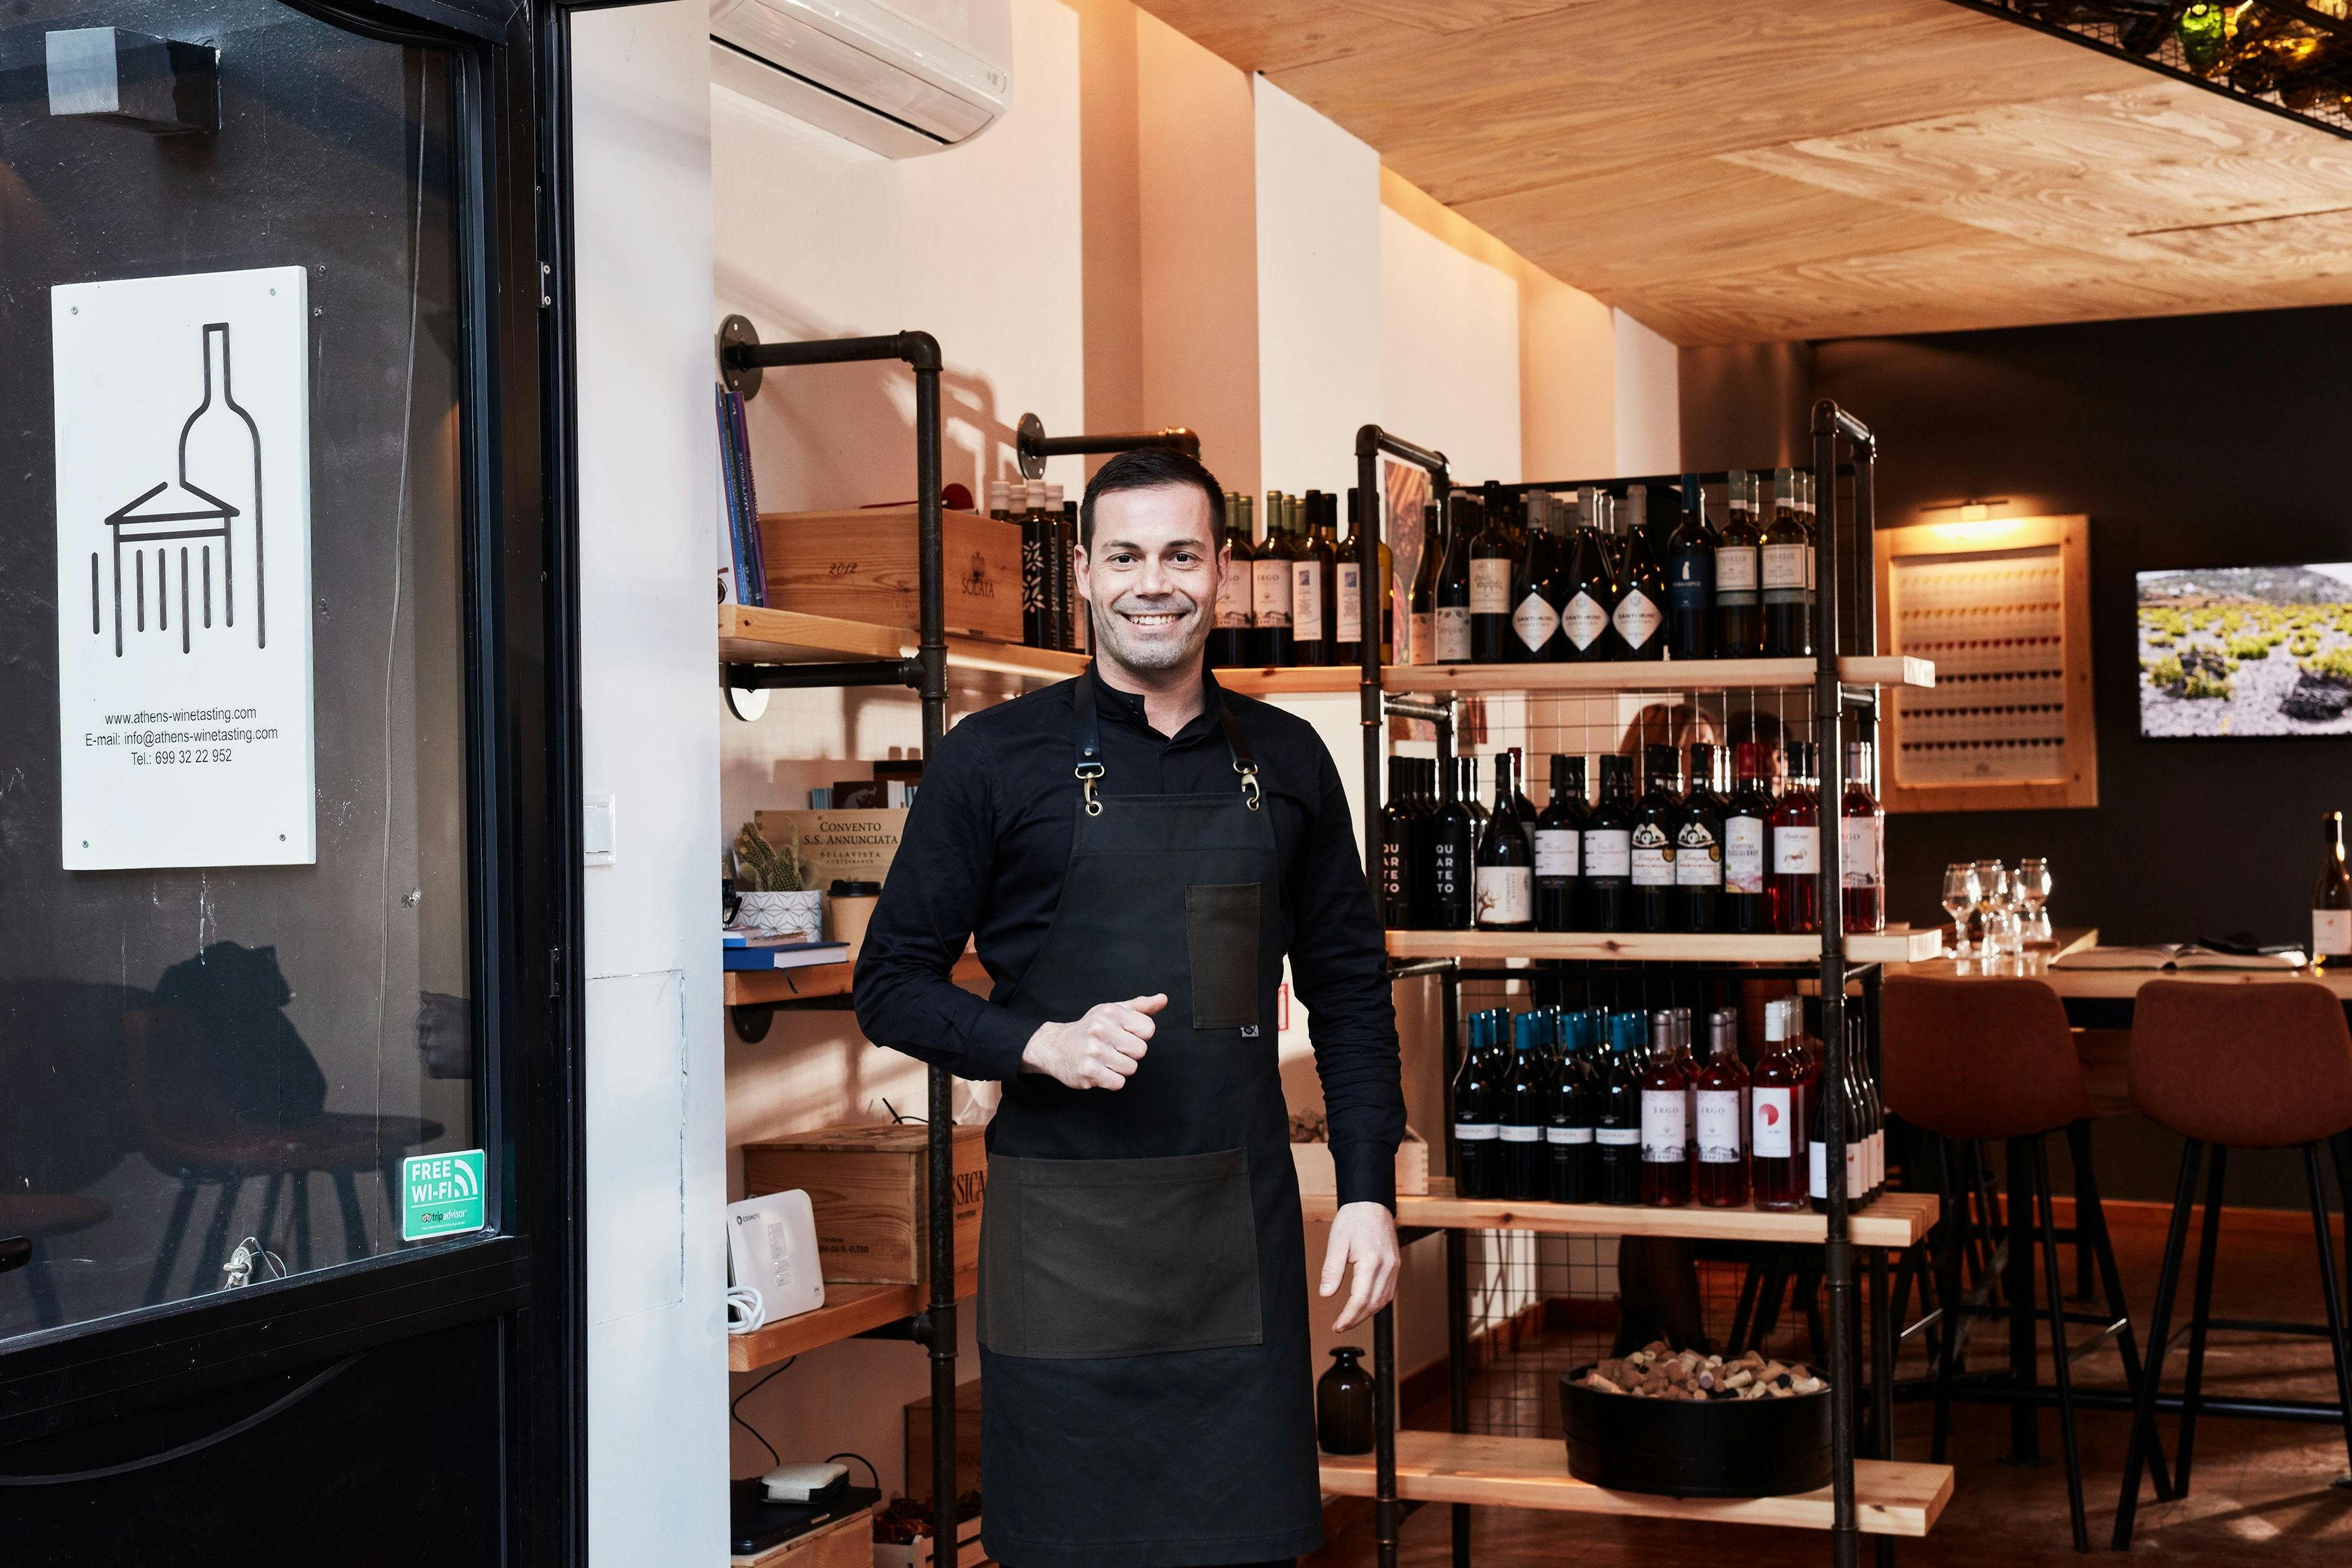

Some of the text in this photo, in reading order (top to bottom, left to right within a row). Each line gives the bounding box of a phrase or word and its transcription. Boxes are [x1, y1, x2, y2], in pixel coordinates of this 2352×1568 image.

[828, 562, 858, 575] 2012
[105, 707, 257, 725] www.athens-winetasting.com
[85, 727, 278, 747] E-mail: info@athens-winetasting.com
[131, 748, 232, 765] Tel.: 699 32 22 952
[820, 822, 881, 832] CONVENTO
[804, 835, 897, 845] S.S. ANNUNCIATA
[1436, 844, 1454, 854] QU
[1436, 857, 1454, 867] AR
[1436, 870, 1452, 880] TE
[1436, 883, 1455, 893] TO
[412, 1159, 451, 1182] FREE
[411, 1181, 452, 1203] WI-FI
[432, 1209, 466, 1222] tripadvisor
